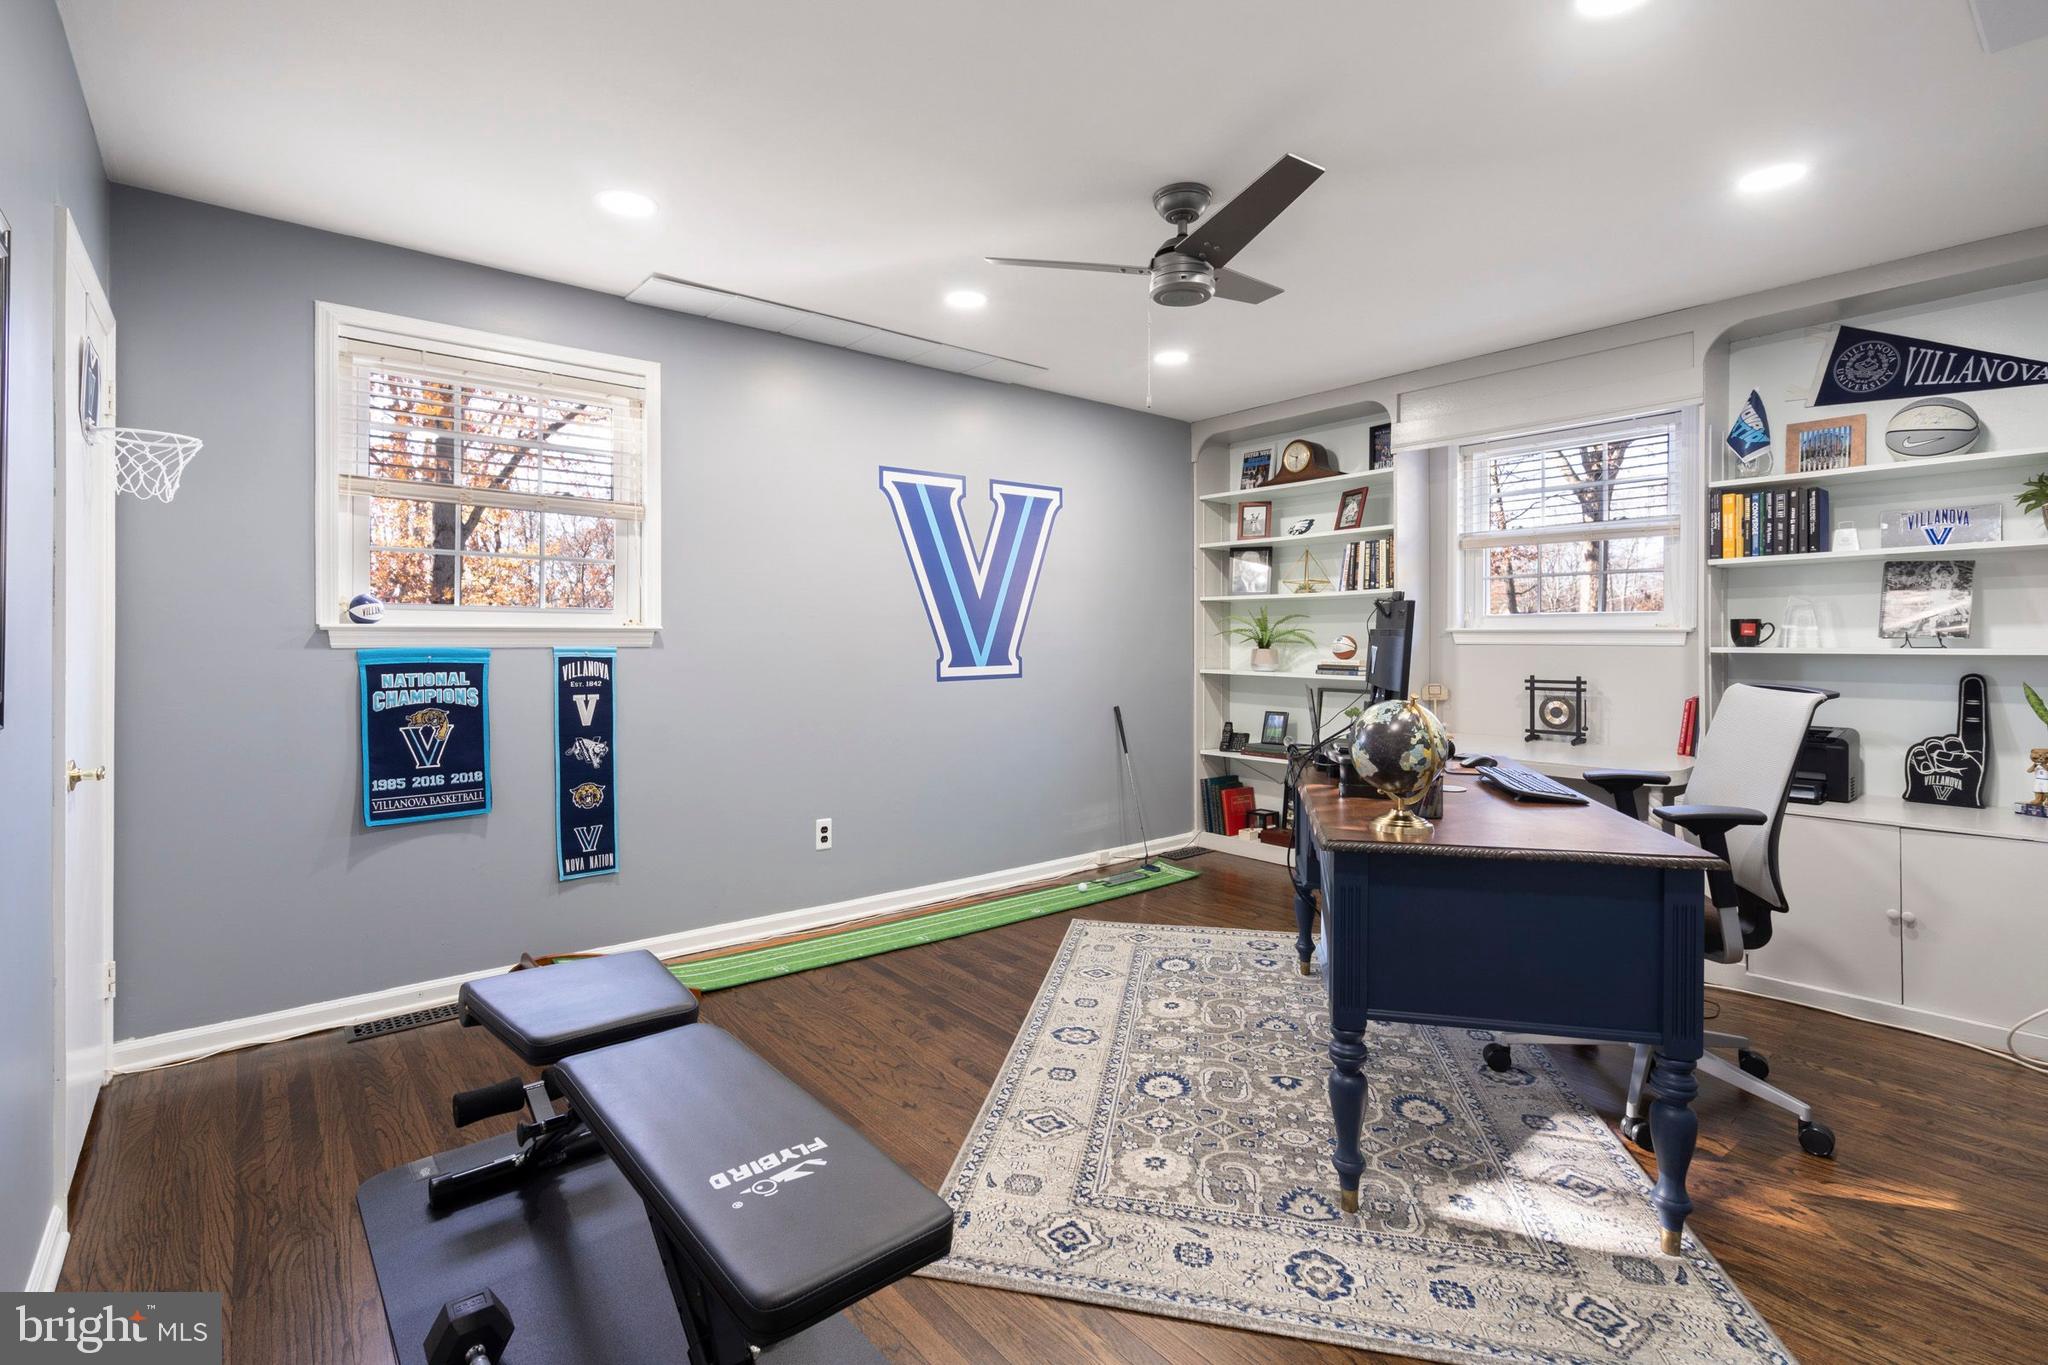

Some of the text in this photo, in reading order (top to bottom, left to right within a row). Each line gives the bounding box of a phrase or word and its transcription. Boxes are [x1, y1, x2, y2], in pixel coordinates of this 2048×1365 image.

[1841, 344, 1896, 362] VILLANOVA
[1904, 346, 2048, 387] VILLANOVA
[1837, 369, 1893, 391] UNIVERSITY
[1908, 509, 1970, 530] VILLANOVA
[879, 465, 1063, 682] V
[381, 671, 470, 689] NATIONAL
[562, 660, 610, 681] VILLANOVA
[372, 687, 479, 712] CHAMPIONS
[572, 693, 600, 727] V
[372, 771, 483, 792] 1985 2016 2018
[1924, 775, 1963, 791] VILLANOVA
[372, 791, 485, 811] VILLANOVA BASKETBALL
[573, 824, 603, 853] V
[565, 852, 614, 873] NOVA NATION
[709, 1137, 829, 1190] FLYBIRD
